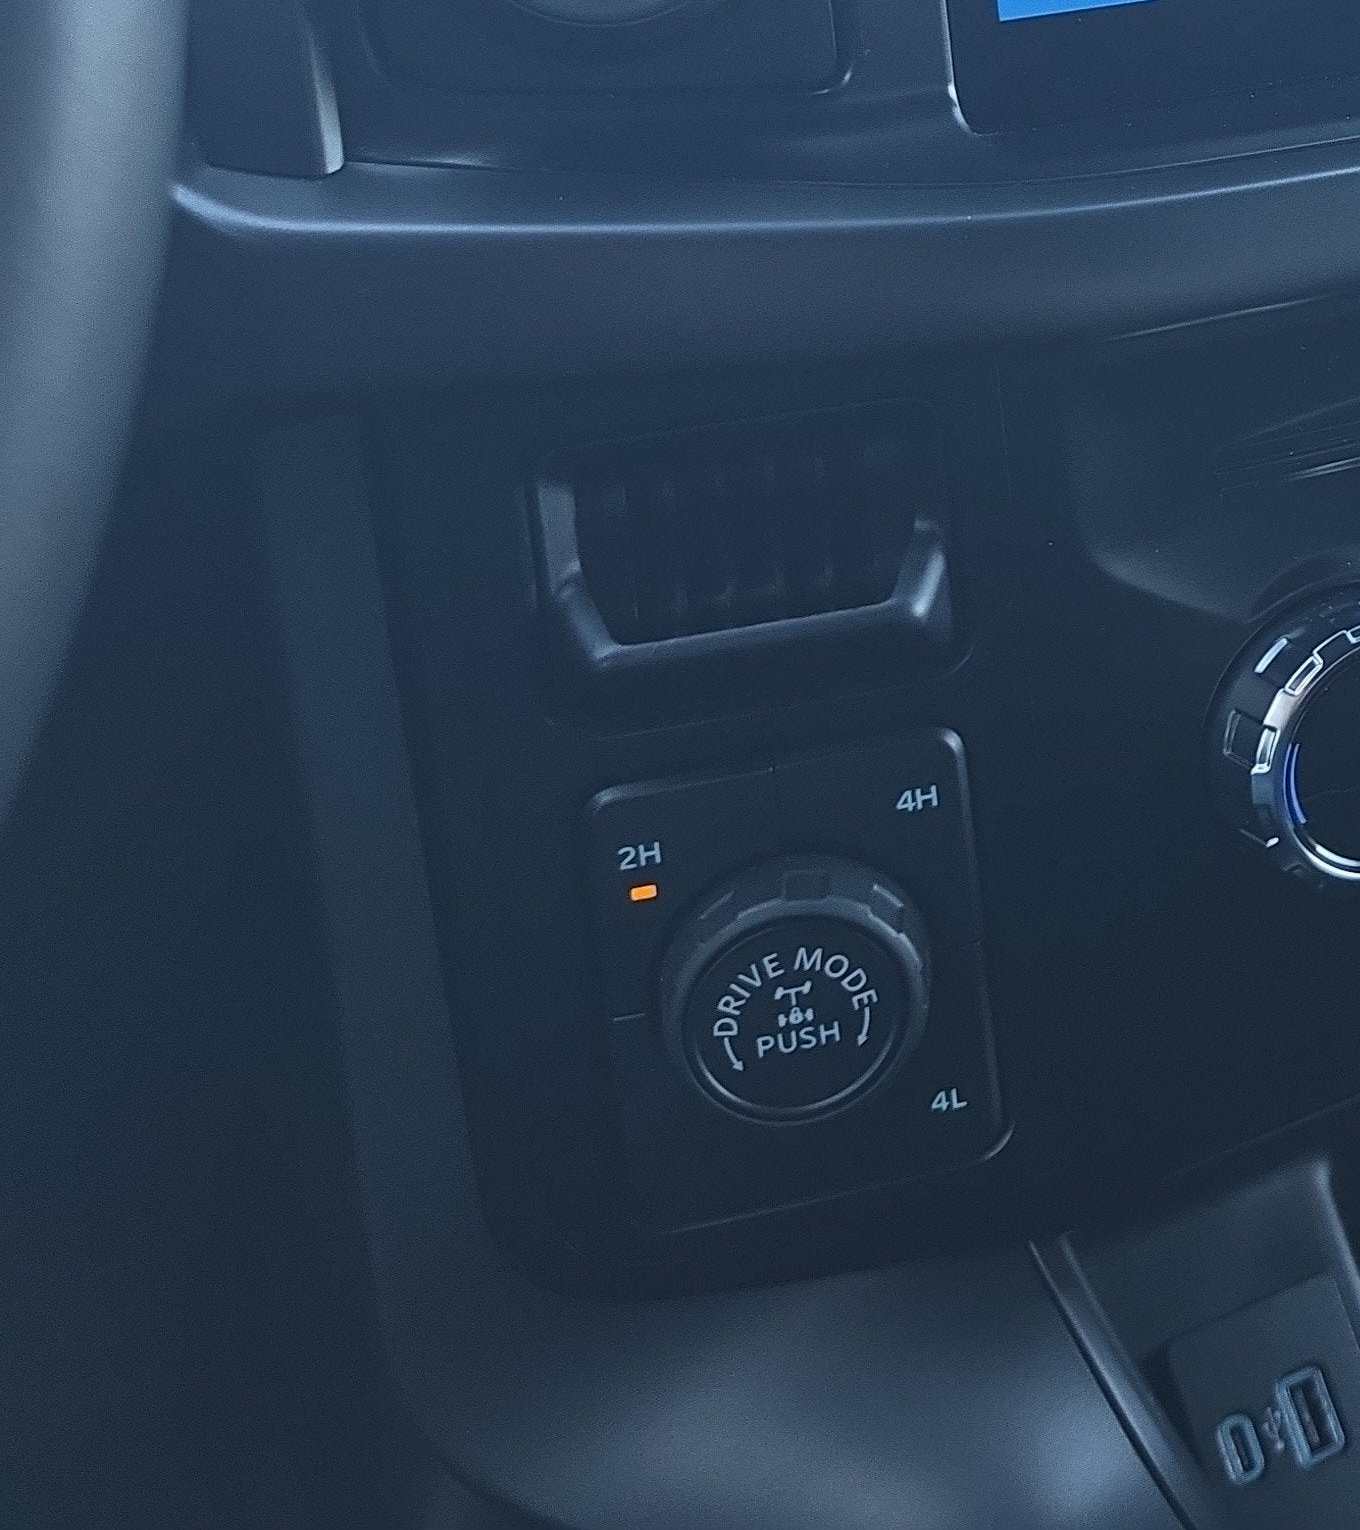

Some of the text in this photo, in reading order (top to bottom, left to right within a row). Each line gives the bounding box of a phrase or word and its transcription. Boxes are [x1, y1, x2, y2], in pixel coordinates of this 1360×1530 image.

[896, 784, 940, 812] 4H
[617, 841, 663, 871] 2H
[713, 946, 879, 1038] DRIVE MODE
[756, 1021, 842, 1059] PUSH
[930, 1086, 968, 1113] 4L
